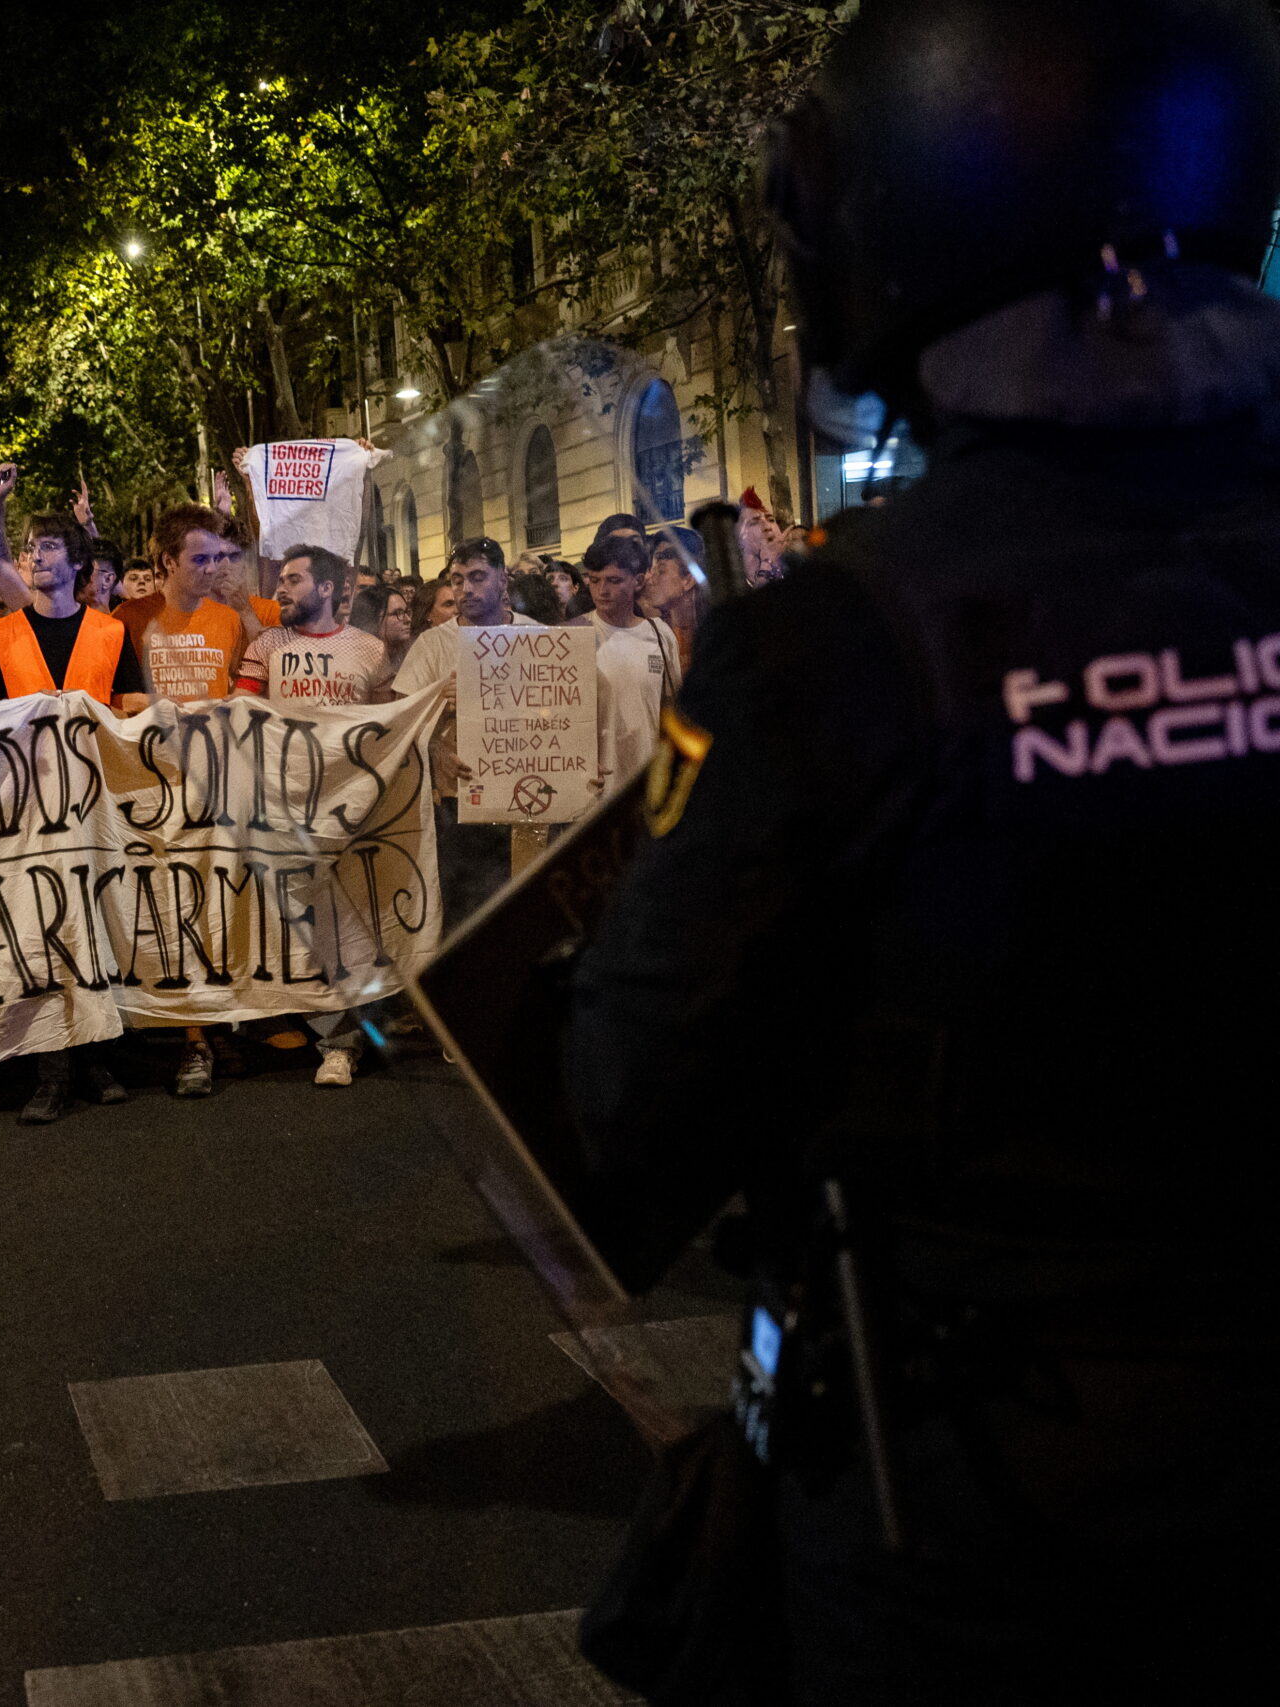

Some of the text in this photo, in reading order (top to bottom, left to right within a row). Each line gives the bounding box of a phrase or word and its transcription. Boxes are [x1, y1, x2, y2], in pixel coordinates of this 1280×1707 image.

[272, 444, 329, 462] IGNORE
[274, 462, 321, 479] AYUSO
[269, 479, 324, 496] ORDERS
[150, 634, 205, 648] SINDICATO
[473, 631, 571, 660] SOMOS
[151, 650, 164, 665] DE
[281, 651, 334, 677] MST
[152, 669, 158, 682] E
[479, 662, 578, 684] LXS NIETXS
[167, 682, 208, 696] MADRID
[480, 683, 582, 711] DE LA VECINA
[484, 714, 571, 734] QUE HABÉIS
[482, 735, 561, 754] VENIDO A
[117, 706, 424, 838] SOMOS
[478, 755, 587, 777] DESAHUCIAR
